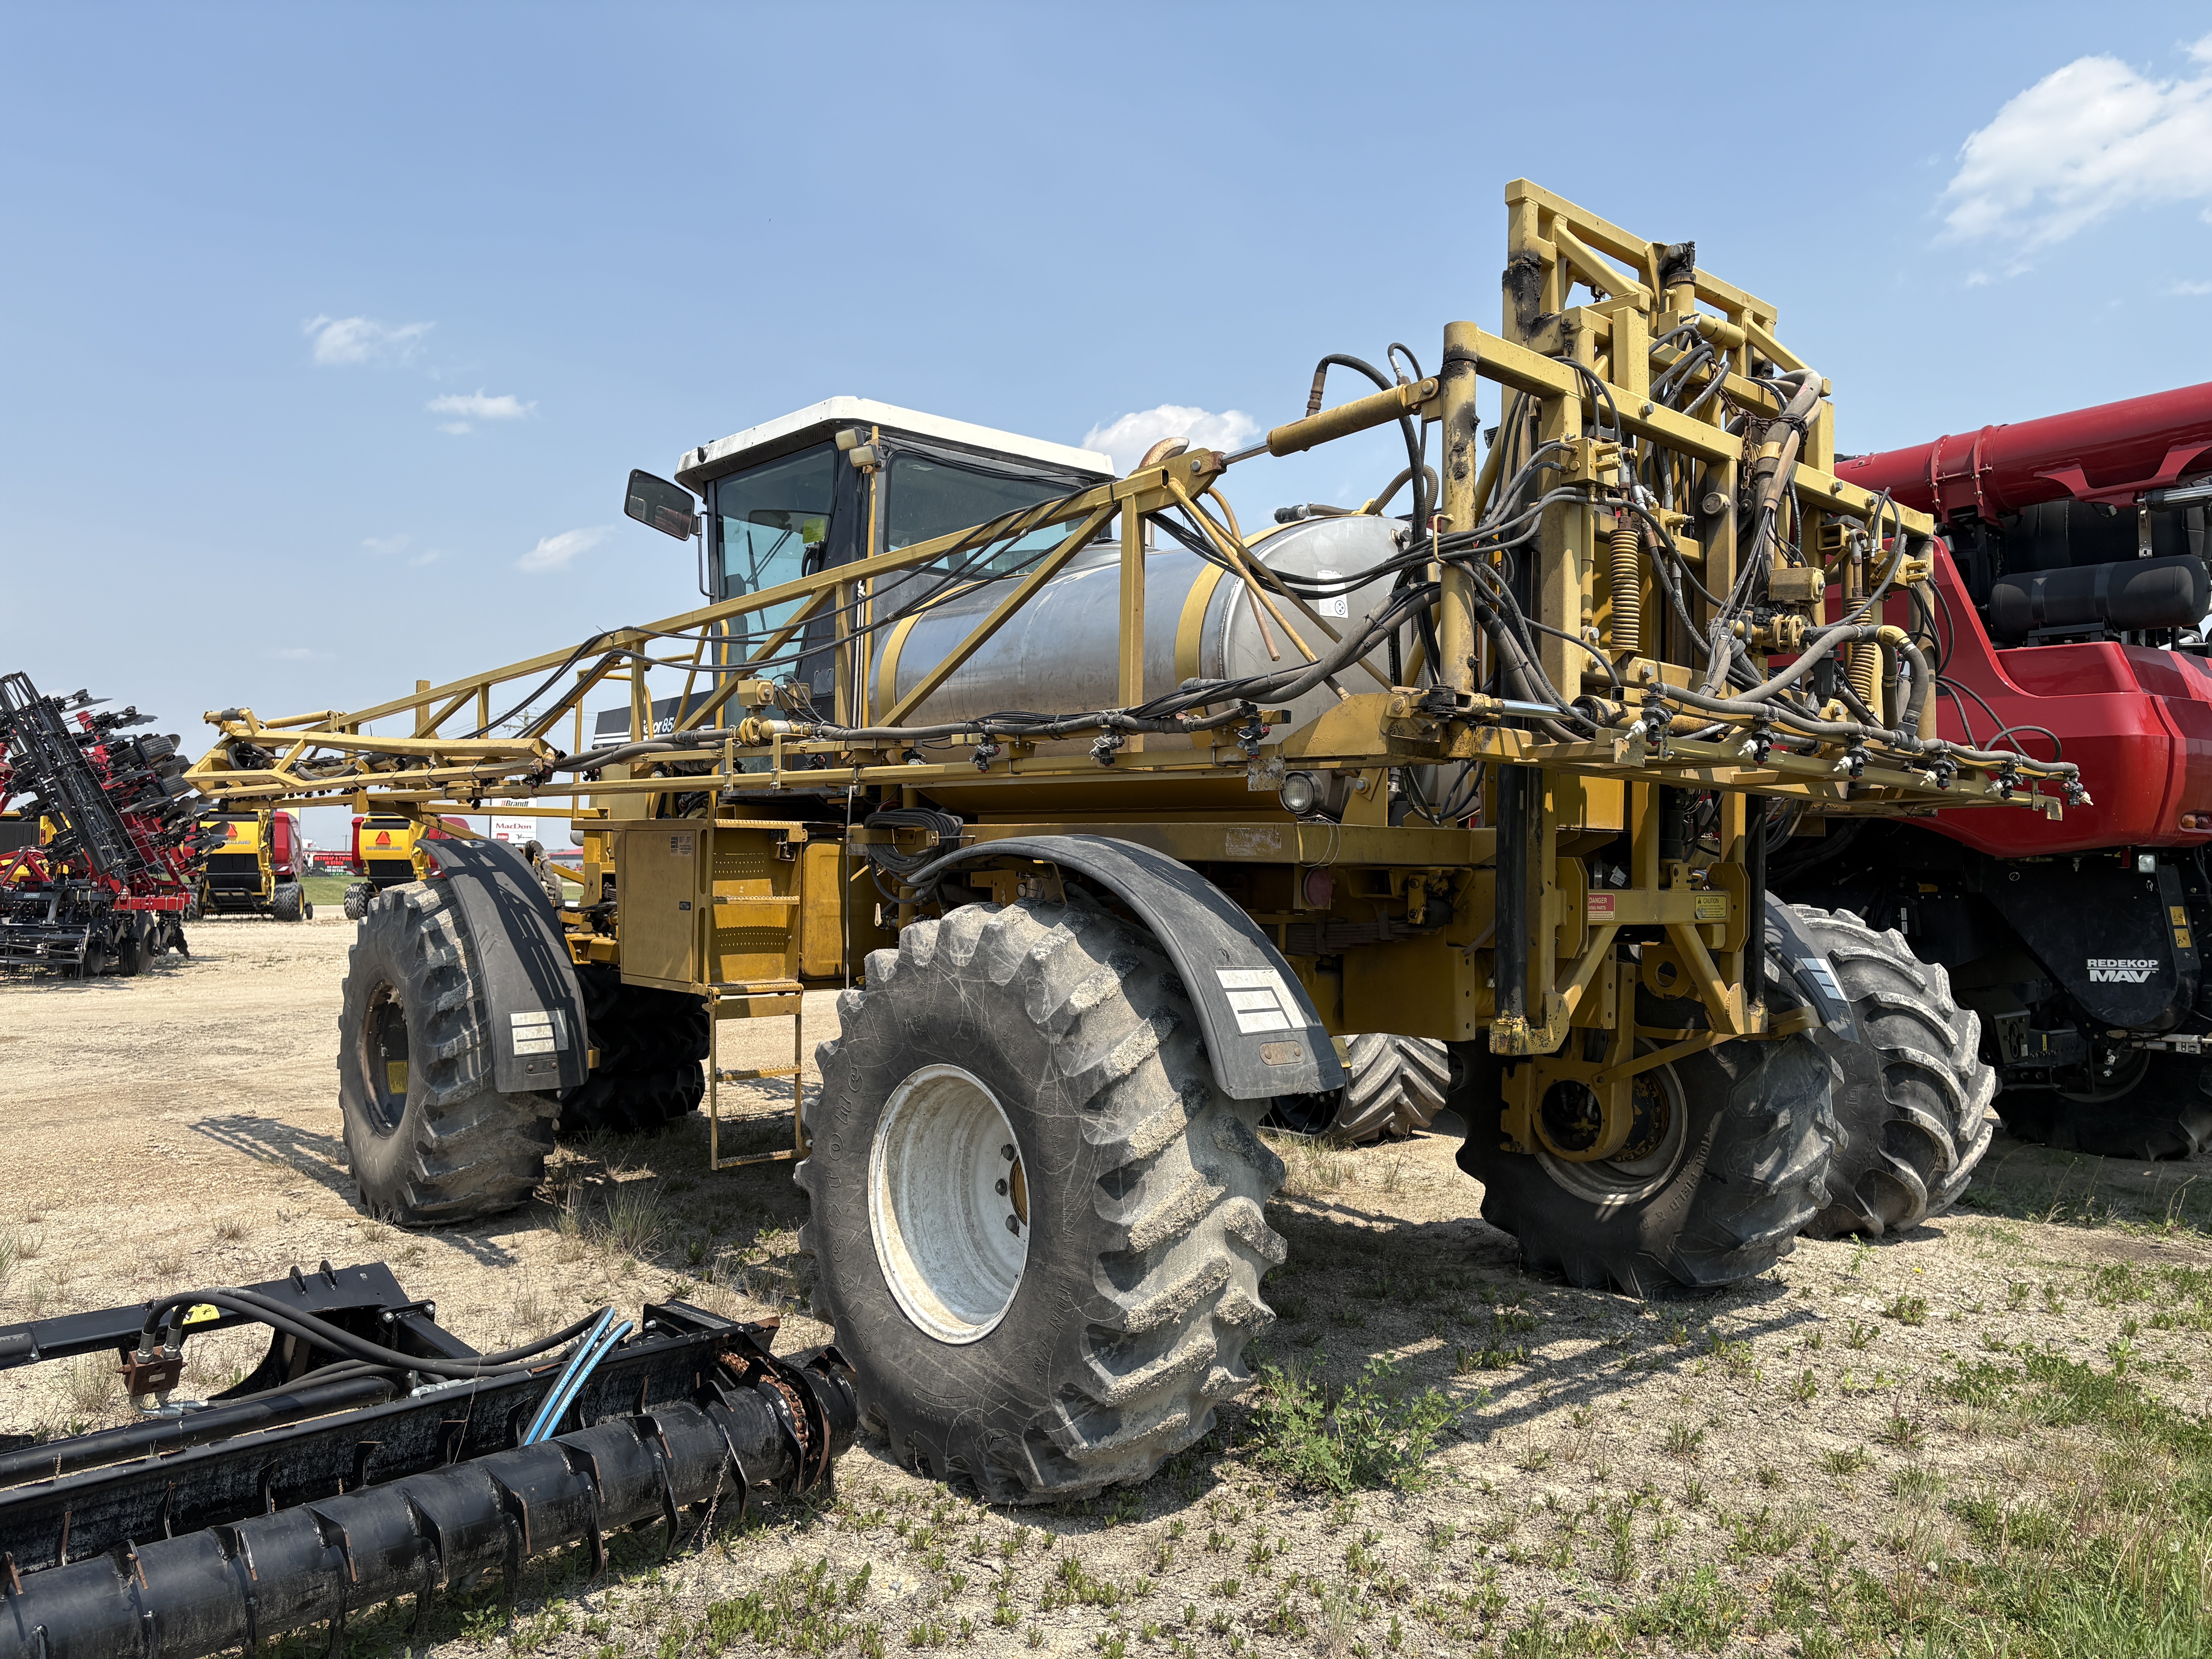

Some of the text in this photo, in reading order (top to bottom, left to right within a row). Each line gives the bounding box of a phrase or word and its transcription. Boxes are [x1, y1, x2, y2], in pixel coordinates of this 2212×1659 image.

[2087, 959, 2158, 968] REDEKOP
[2090, 970, 2151, 983] MAV
[1047, 1114, 1069, 1167] ALL
[826, 1066, 878, 1352] Firestone
[1050, 1187, 1076, 1332] TRACTION
[558, 1372, 572, 1390] KURT
[576, 1346, 589, 1362] BEND
[575, 1371, 589, 1389] MSHA
